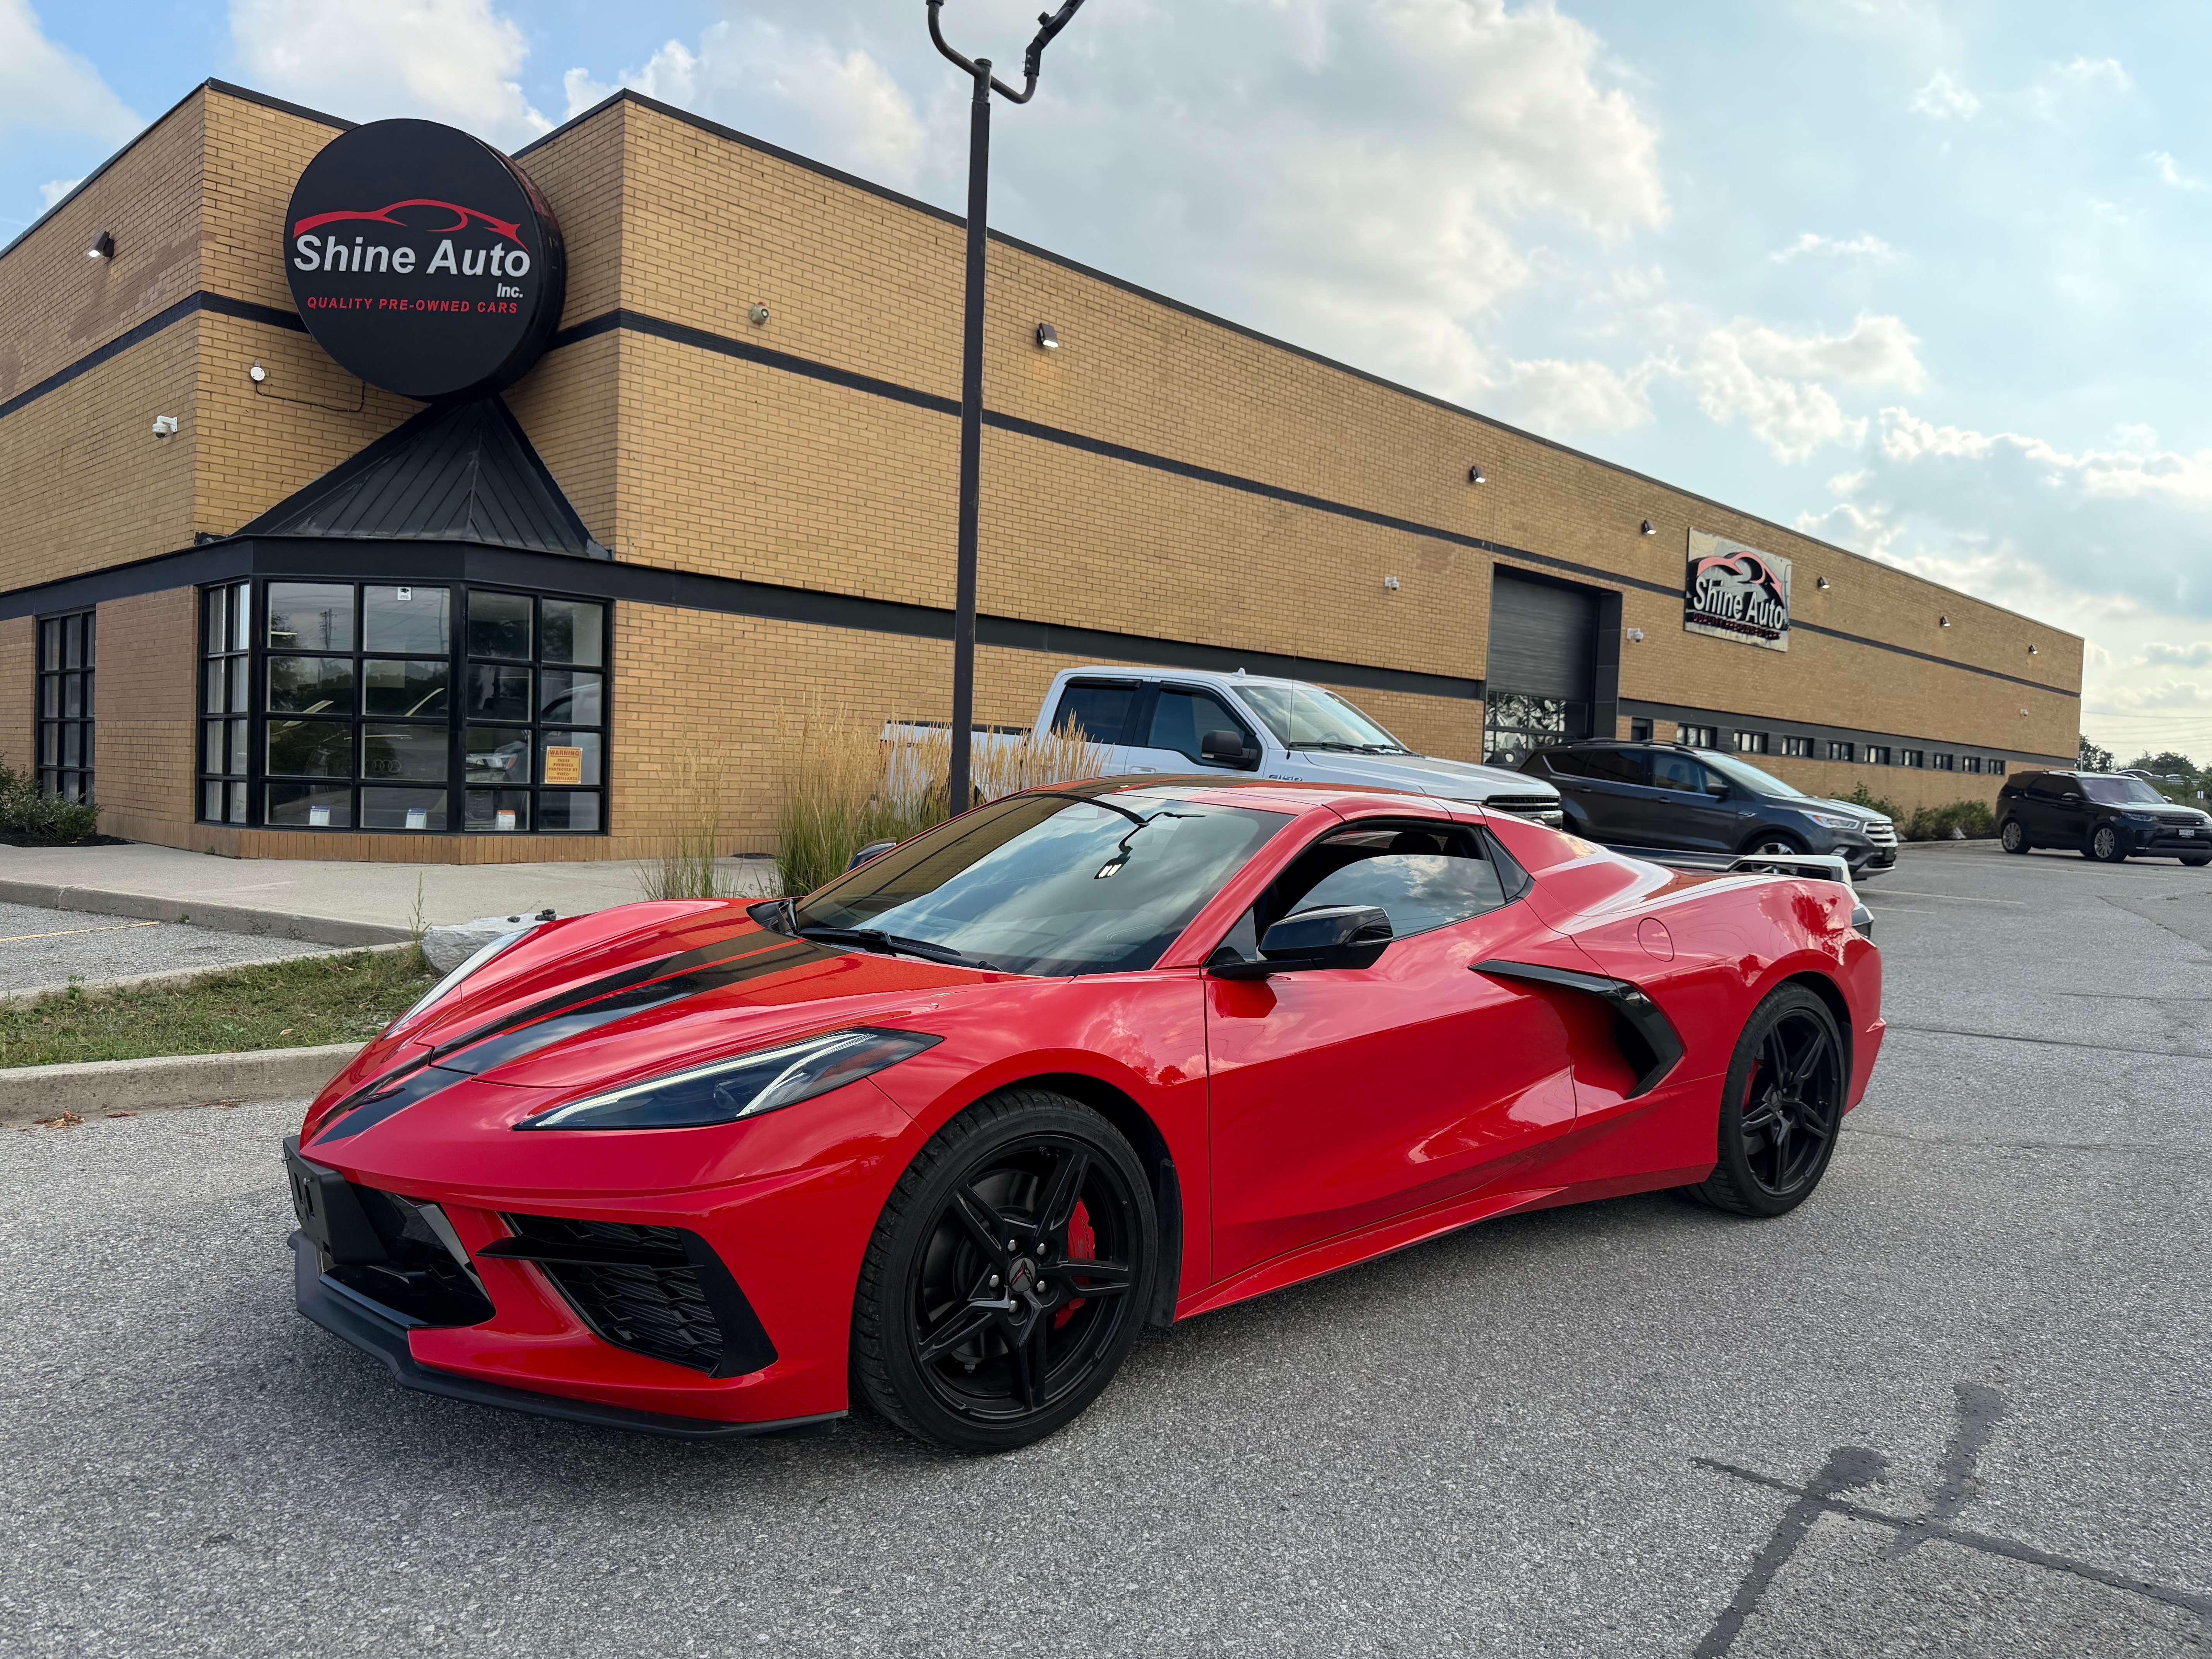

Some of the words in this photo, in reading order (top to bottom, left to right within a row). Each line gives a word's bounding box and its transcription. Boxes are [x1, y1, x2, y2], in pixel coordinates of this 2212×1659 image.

[294, 235, 416, 275] Shine
[426, 239, 531, 278] Auto
[307, 296, 373, 310] QUALITY
[378, 299, 470, 313] PRE-OWNED
[477, 301, 518, 314] CARS
[496, 283, 524, 298] Inc.
[1693, 577, 1743, 619] Shine
[1745, 591, 1783, 630] Auto
